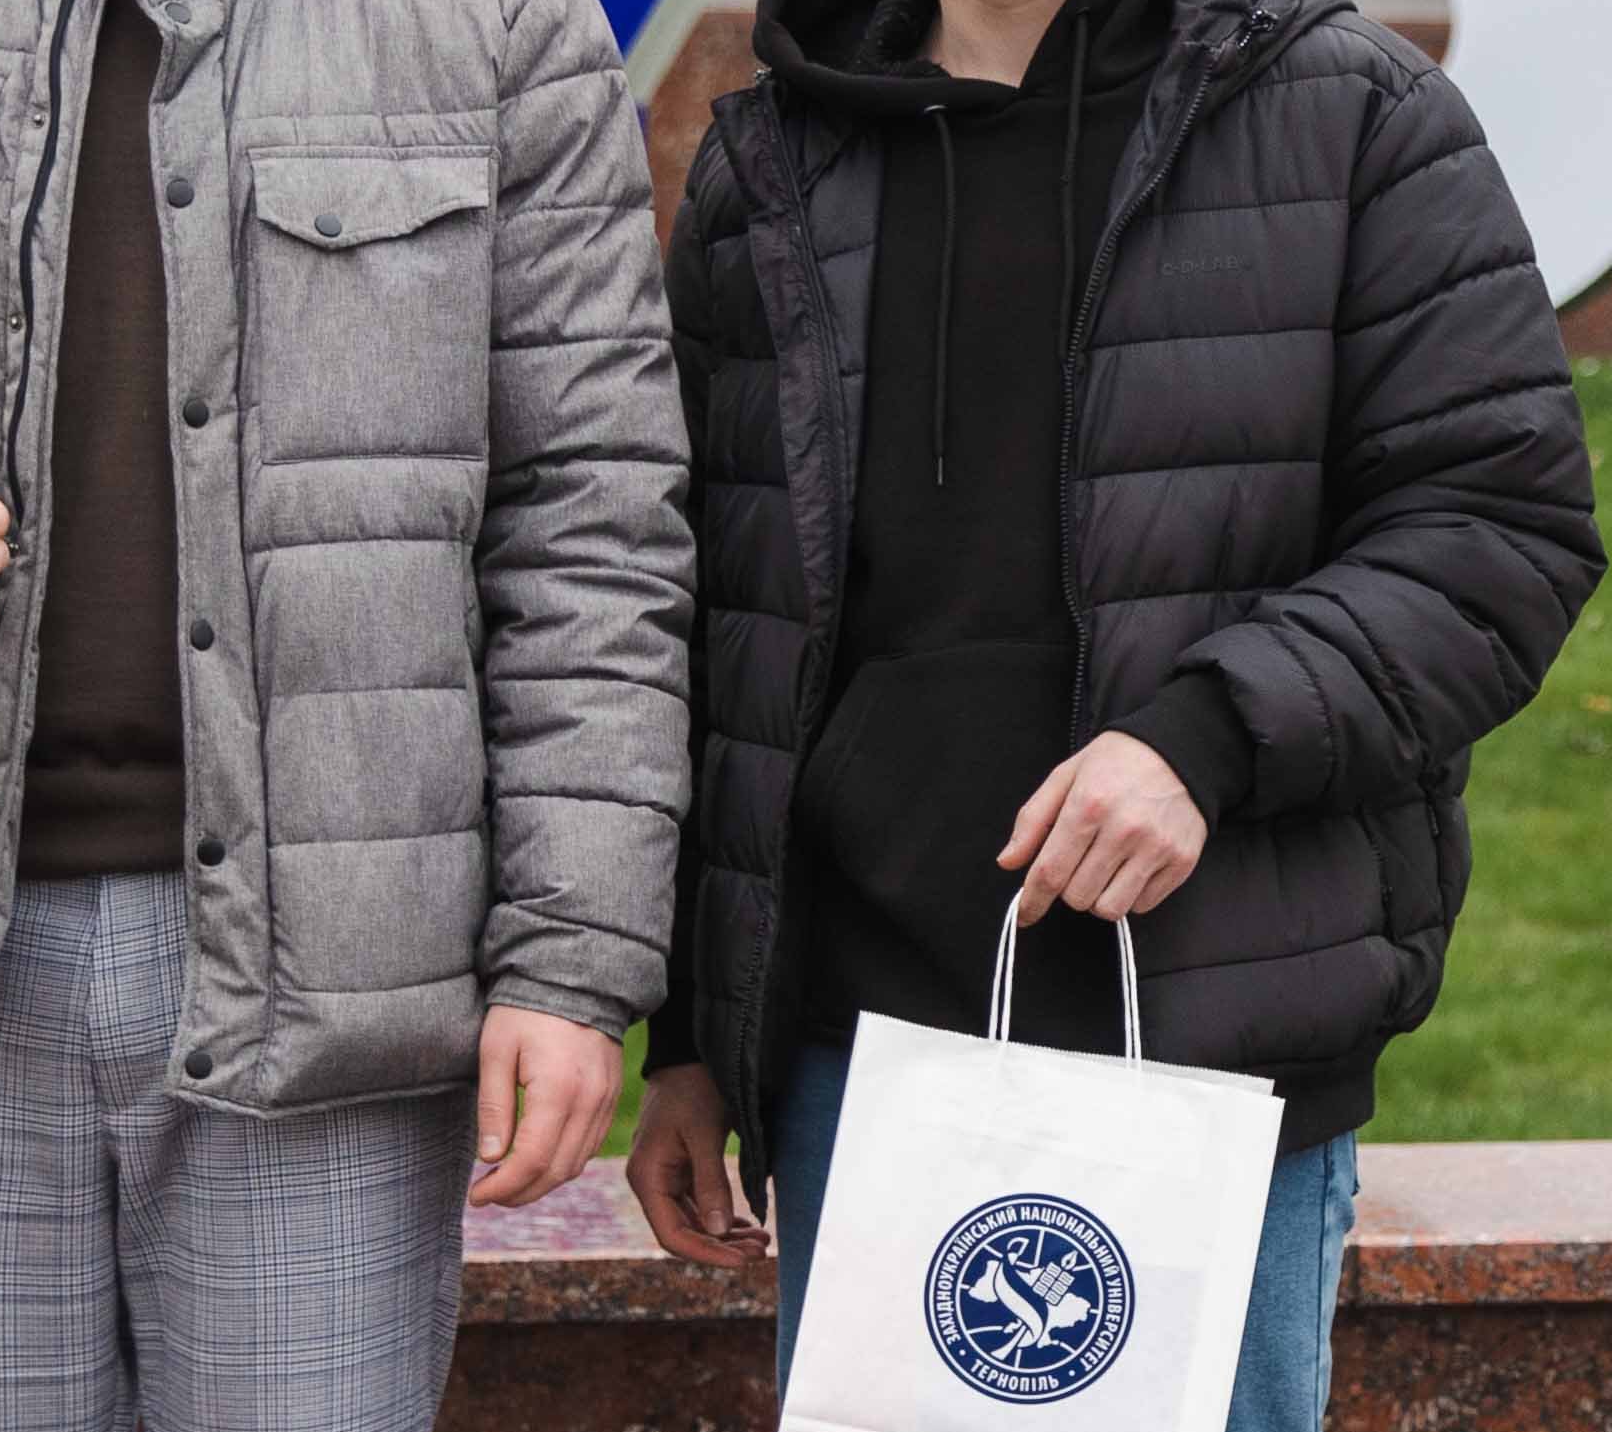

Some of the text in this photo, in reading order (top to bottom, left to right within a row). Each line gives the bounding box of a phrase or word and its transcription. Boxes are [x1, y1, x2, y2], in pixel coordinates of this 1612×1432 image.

[936, 1205, 1124, 1372] ЗАХІДНОУКРАЇНСЬКИЙ НАЦІОНАЛЬНИЙ УНІВЕРСИТЕТ
[969, 1359, 1060, 1393] ТЕРНОПІЛЬ
